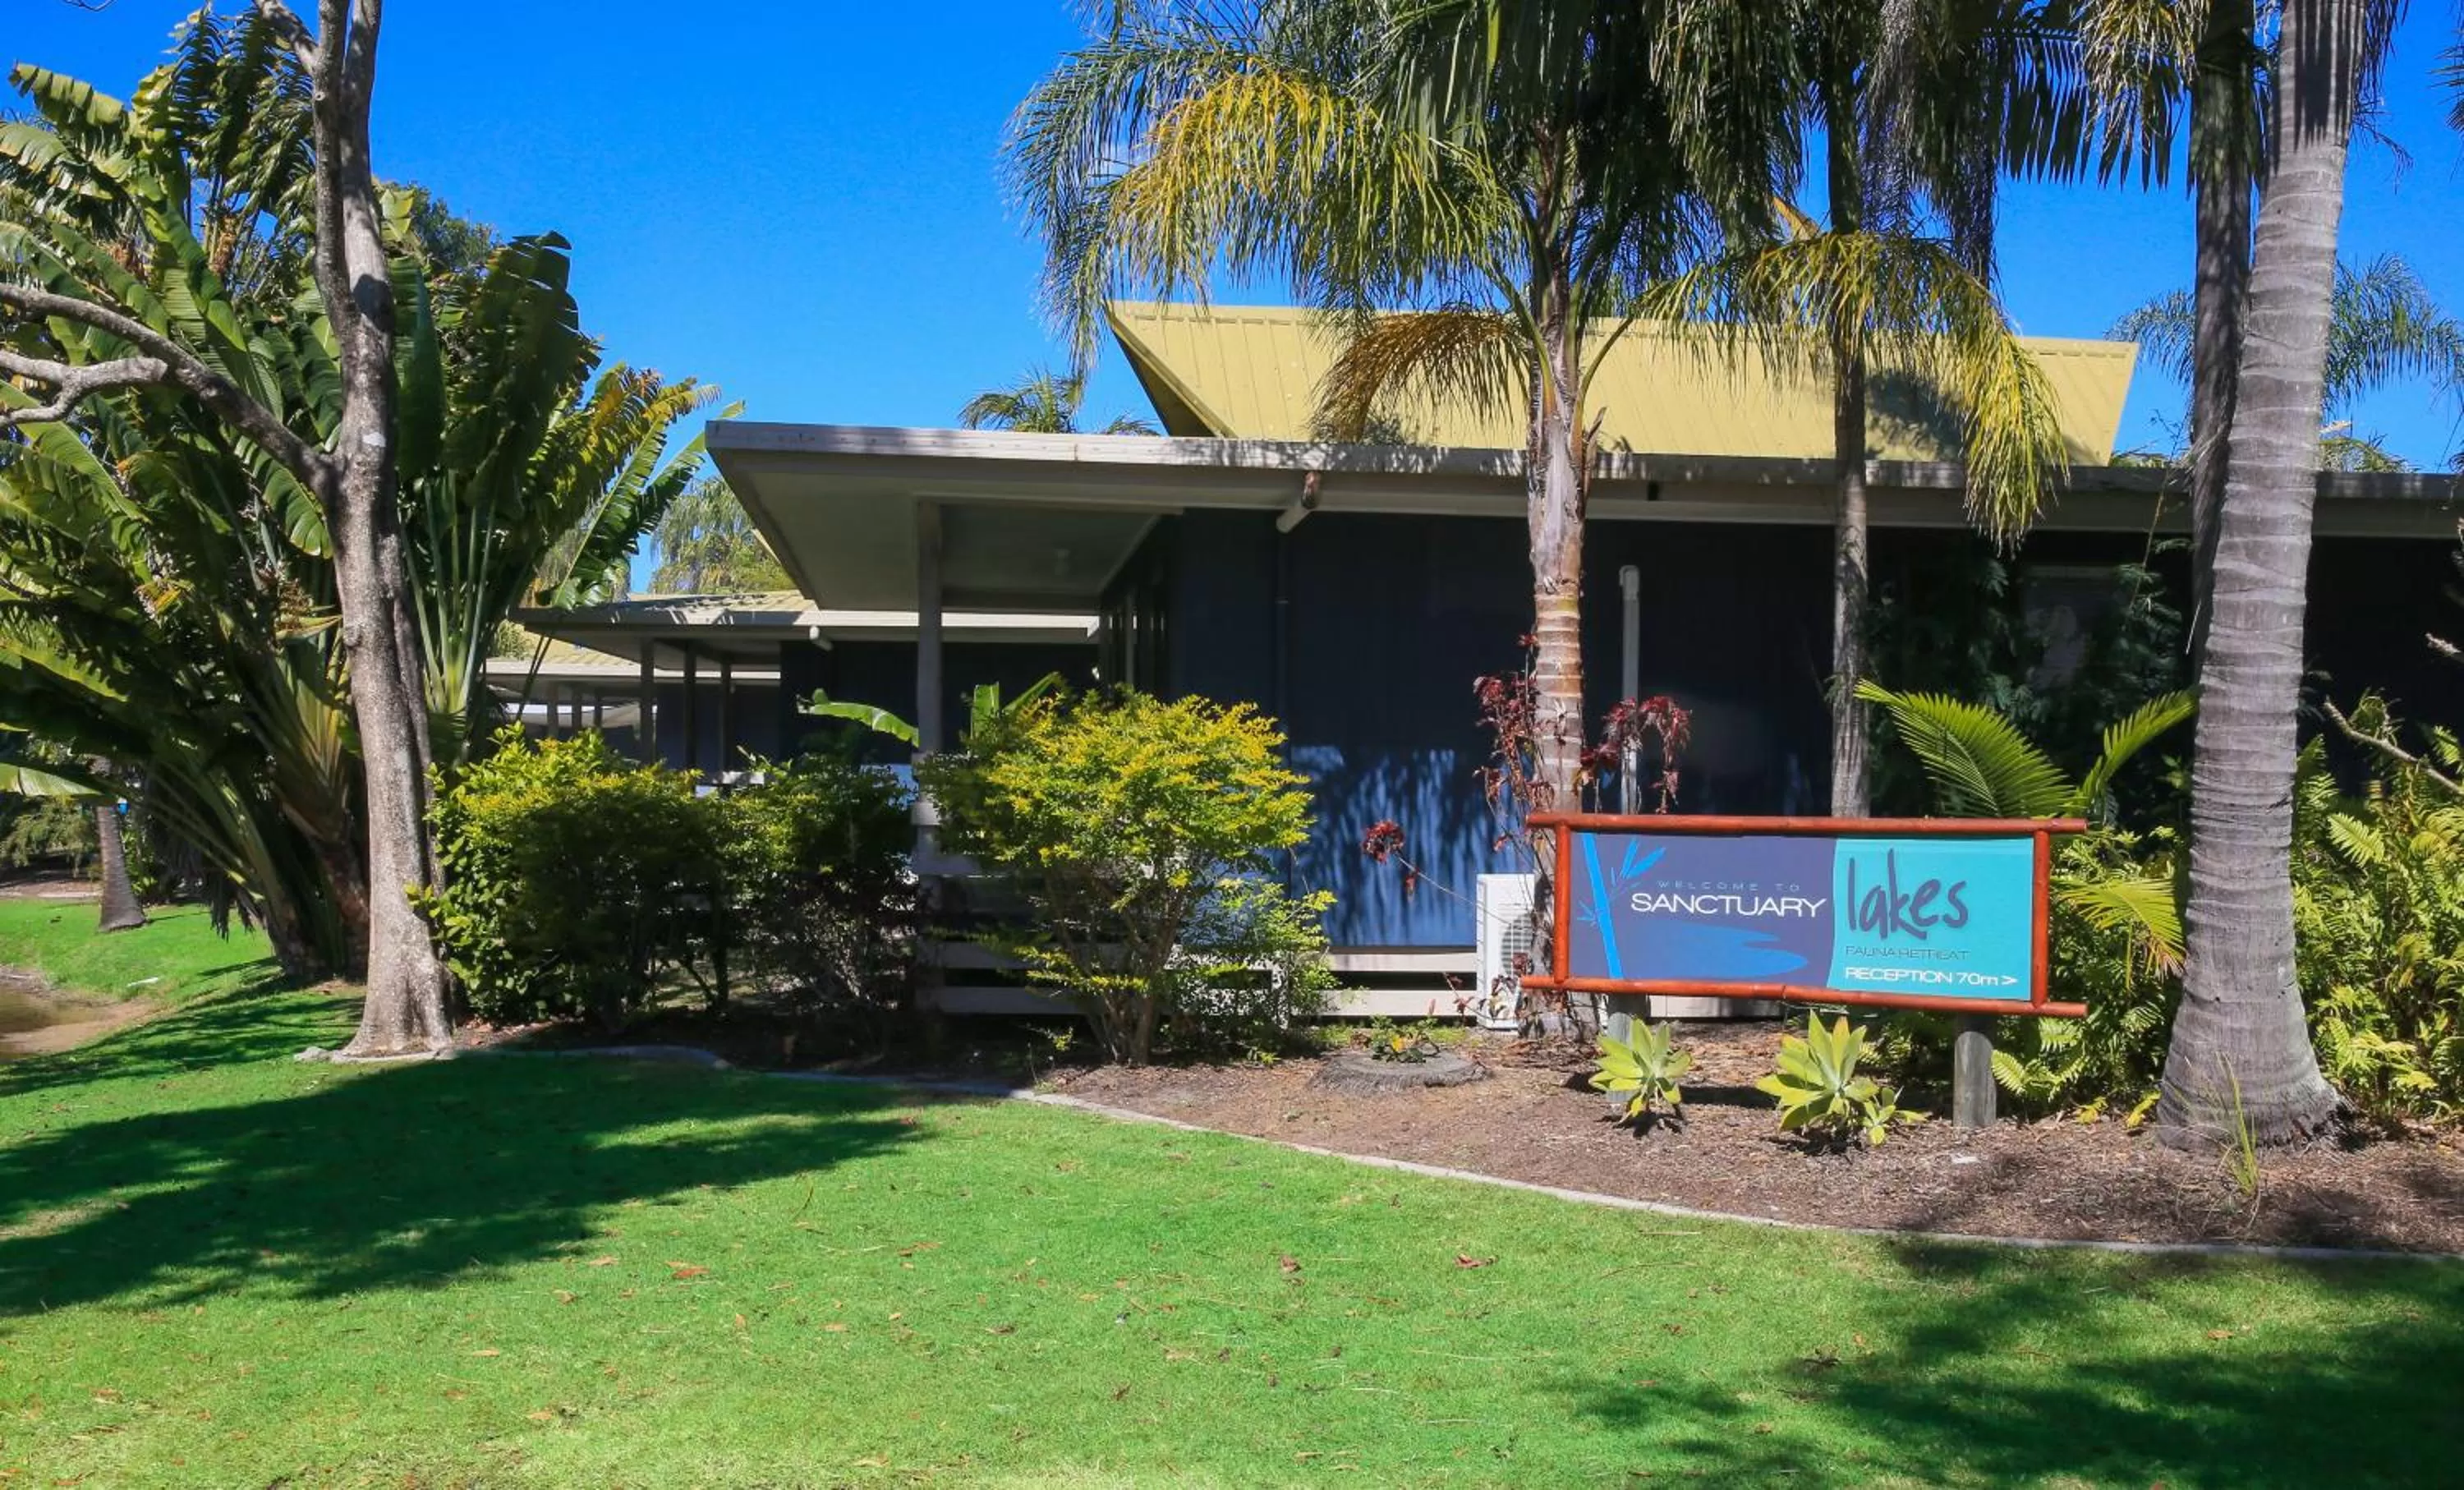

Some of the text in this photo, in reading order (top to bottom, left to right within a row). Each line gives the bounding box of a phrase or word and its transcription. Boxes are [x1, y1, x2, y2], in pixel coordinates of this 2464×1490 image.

[1630, 848, 1969, 940] SANCTUARY lakes
[1657, 880, 1800, 892] WELCOME TO
[1846, 946, 1970, 960] FAUNA RETREAT
[1846, 967, 1997, 986] RECEPTION 70m
